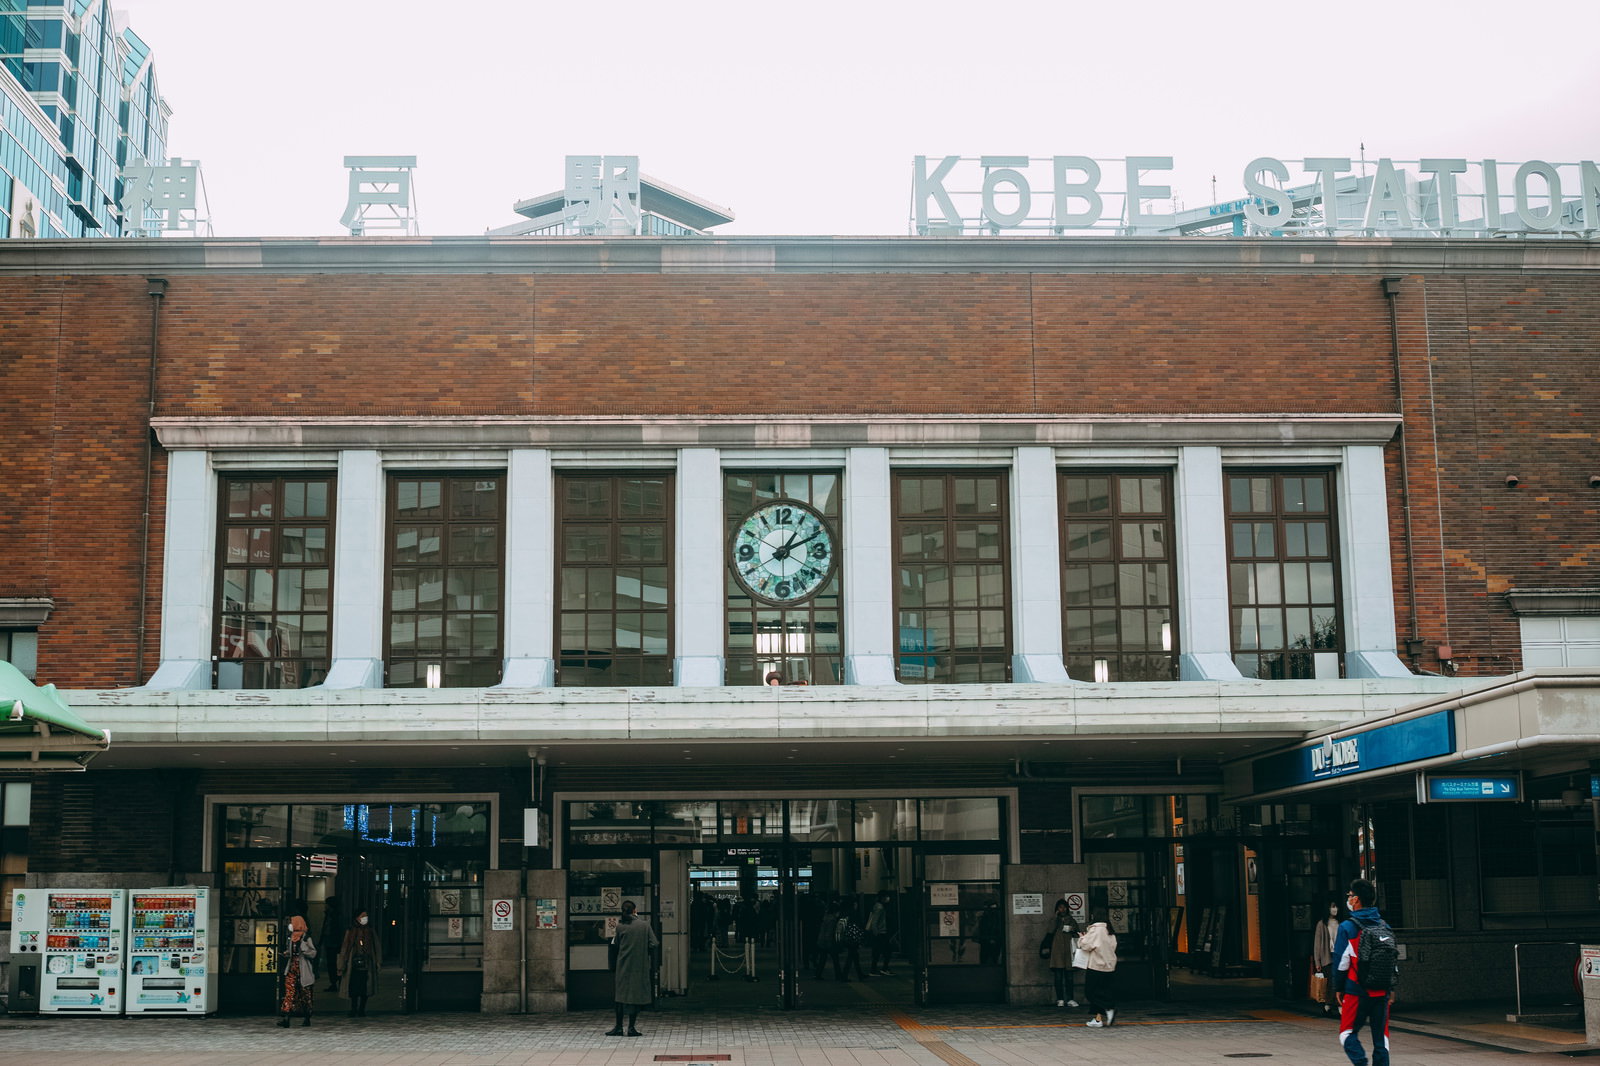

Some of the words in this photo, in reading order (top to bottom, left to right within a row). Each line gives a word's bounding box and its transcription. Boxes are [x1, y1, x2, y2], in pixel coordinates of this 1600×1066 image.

[775, 508, 792, 525] 12
[738, 544, 754, 562] 9
[812, 542, 827, 560] 3
[775, 581, 790, 598] 6
